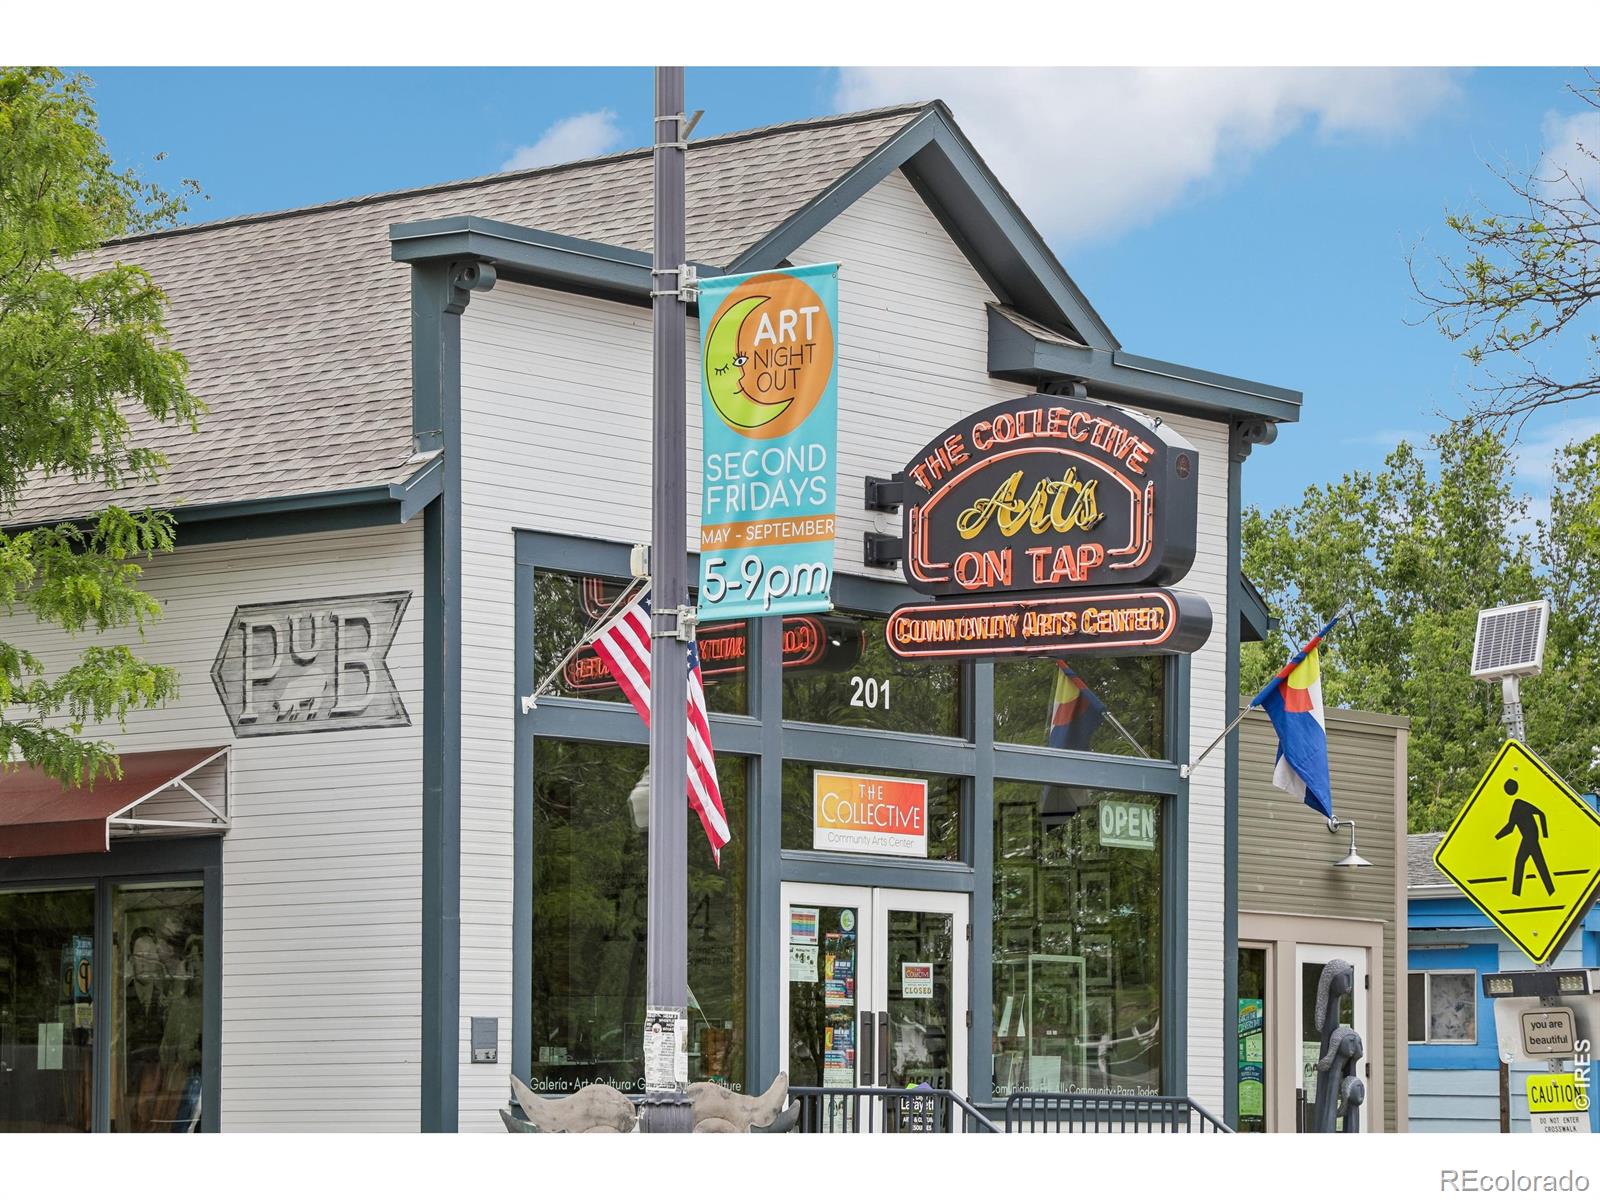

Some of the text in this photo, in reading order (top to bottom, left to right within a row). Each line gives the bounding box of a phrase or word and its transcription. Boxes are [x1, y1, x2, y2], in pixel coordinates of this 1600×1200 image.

[753, 306, 820, 346] ART
[753, 343, 816, 370] NIGHT
[757, 368, 801, 393] OUT
[706, 444, 827, 482] SECOND
[909, 407, 1155, 494] THE COLLECTIVE
[706, 475, 827, 514] FRIDAYS
[956, 467, 1105, 540] Arts
[701, 527, 731, 545] MAY
[745, 519, 834, 540] SEPTEMBER
[703, 555, 831, 610] 5-9pm
[954, 543, 1104, 590] ON TAP
[895, 606, 1165, 644] COMMUNITY ARTS CENTER
[850, 676, 890, 710] 201
[858, 784, 884, 800] THE
[821, 792, 920, 829] COLLECTIVE
[1101, 805, 1154, 838] OPEN
[827, 832, 914, 848] Community Arts Center
[904, 987, 932, 995] CLOSED
[1529, 1034, 1568, 1045] beautiful
[1530, 1021, 1563, 1031] you are
[530, 1076, 567, 1090] Galería
[1563, 1116, 1579, 1124] ENTER
